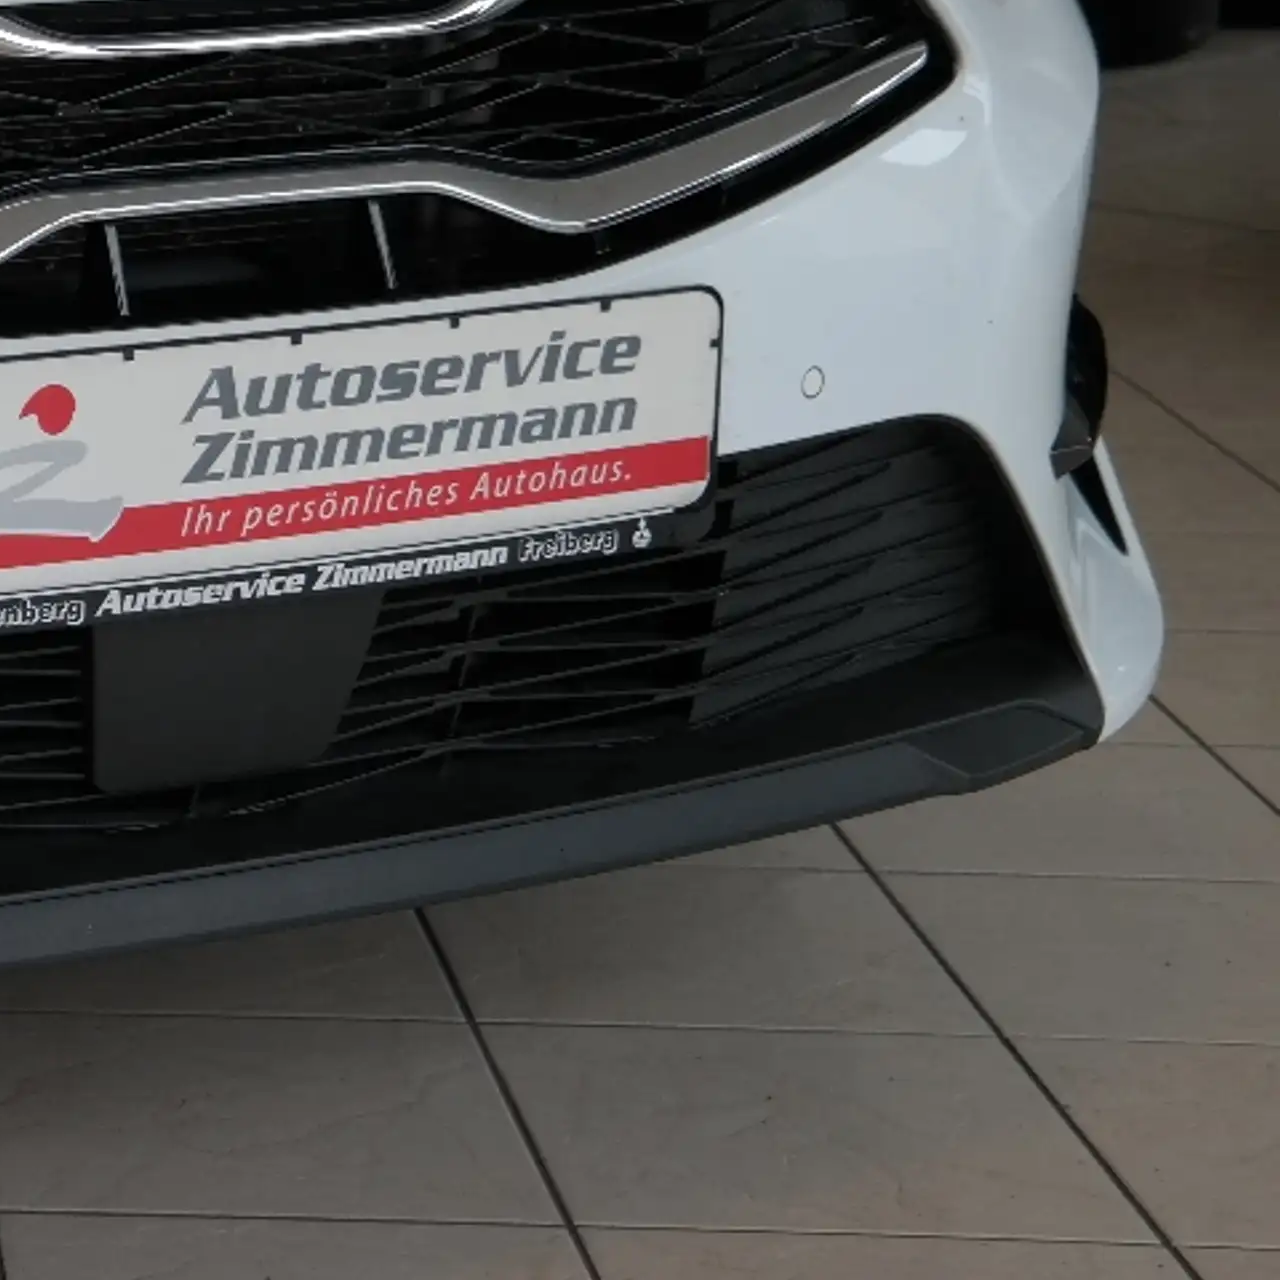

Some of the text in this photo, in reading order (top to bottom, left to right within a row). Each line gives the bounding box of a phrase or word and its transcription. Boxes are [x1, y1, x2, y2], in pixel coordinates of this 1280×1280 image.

[181, 331, 643, 424] Autoservice
[181, 397, 637, 484] Zimmermann
[181, 457, 632, 537] Ihr persönliches Autohaus.
[95, 569, 305, 617] Autoservice
[312, 545, 508, 591] Zimmermann
[518, 528, 619, 562] Freiberg
